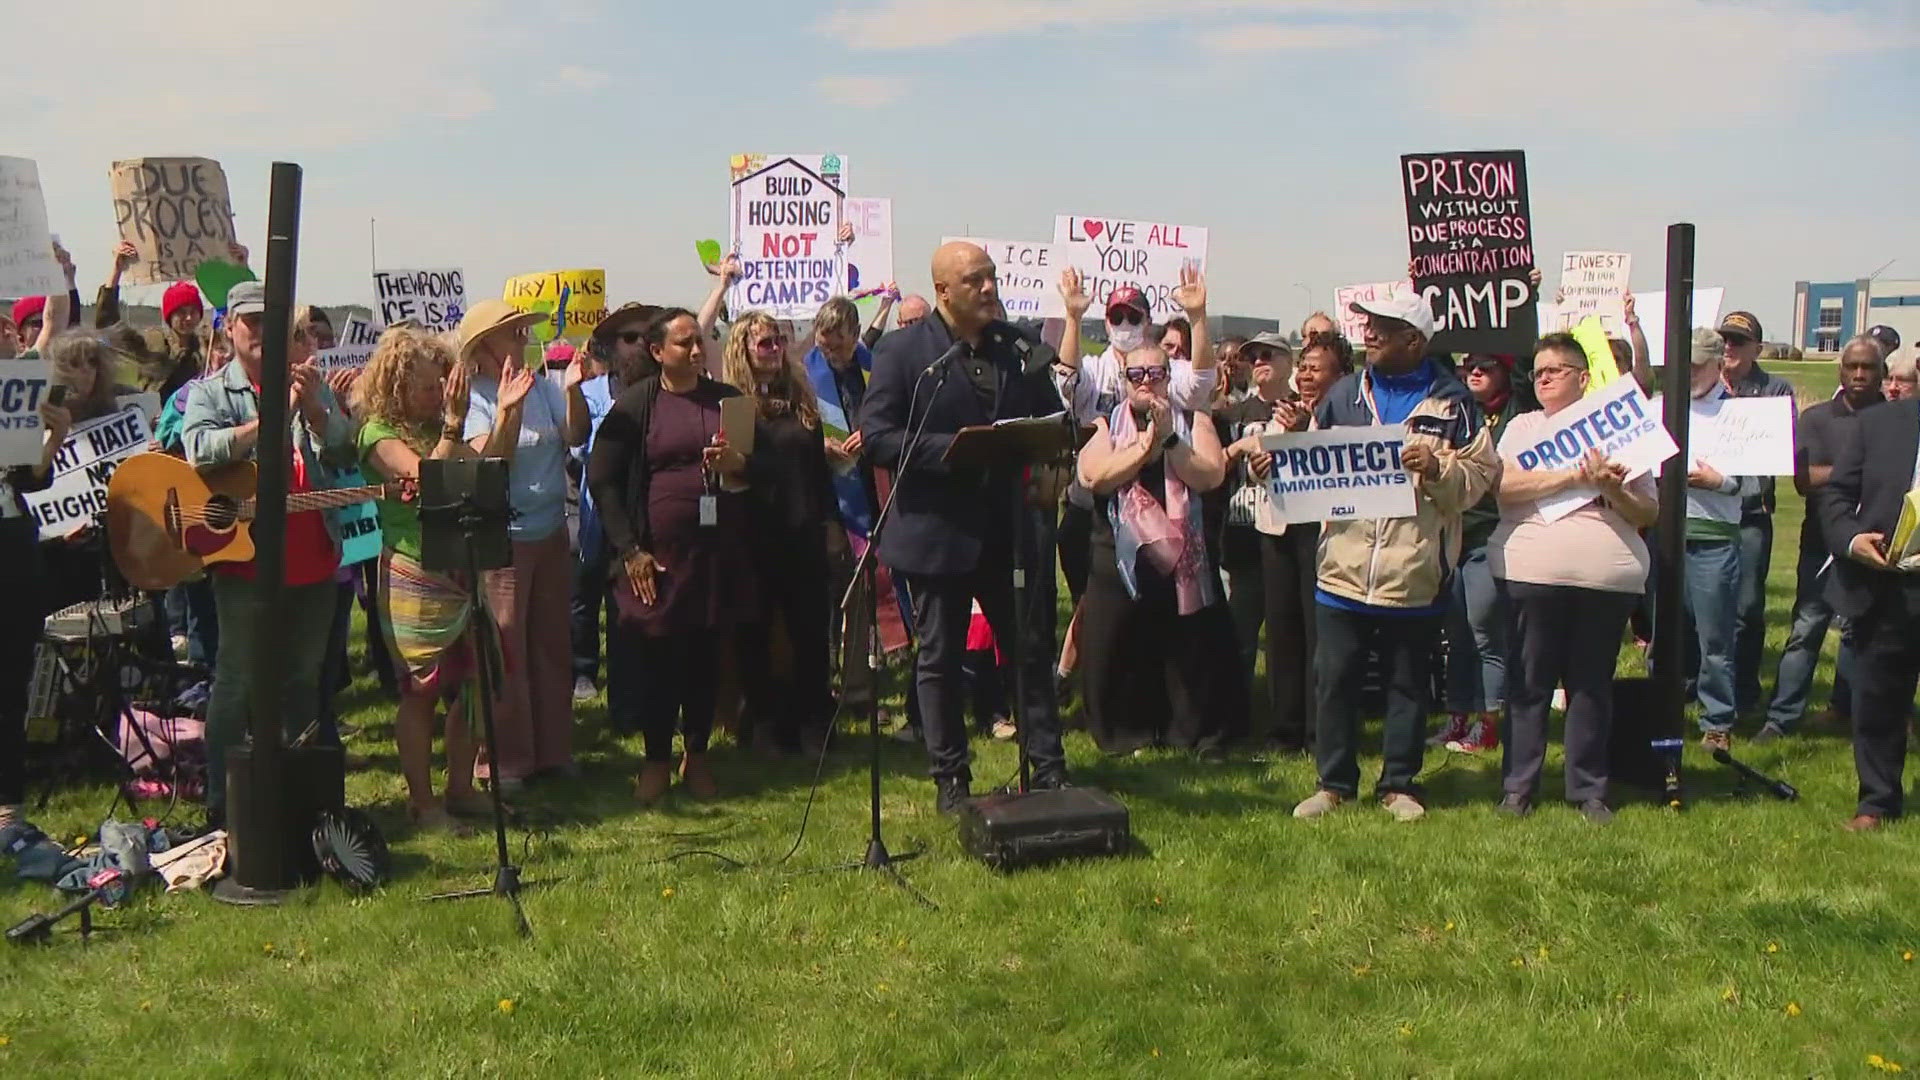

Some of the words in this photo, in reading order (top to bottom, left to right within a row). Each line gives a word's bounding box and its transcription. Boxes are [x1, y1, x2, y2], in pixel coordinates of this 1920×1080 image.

[131, 163, 208, 197] DUE
[766, 176, 812, 196] BUILD
[1407, 158, 1515, 200] PRISON
[114, 196, 235, 242] PROCESS
[749, 200, 831, 227] HOUSING
[1420, 199, 1519, 219] WITHOUT
[1147, 224, 1189, 248] ALL
[1411, 222, 1448, 243] DUE
[1449, 216, 1526, 240] PROCESS
[158, 241, 175, 259] IS
[187, 241, 206, 256] A
[762, 232, 818, 259] NOT
[1449, 240, 1466, 250] IS
[1472, 238, 1483, 249] A
[1004, 246, 1048, 267] ICE
[1095, 244, 1149, 276] YOUR
[1413, 245, 1532, 278] CONCENTRATION
[1564, 254, 1627, 271] INVEST
[147, 259, 198, 282] RIG
[744, 259, 834, 280] DETENTION
[996, 271, 1044, 290] ntion
[373, 272, 412, 299] THE
[411, 271, 464, 298] WRONG
[513, 278, 545, 298] TRY
[551, 271, 603, 296] TALKS
[747, 280, 830, 305] CAMPS
[1337, 285, 1375, 304] End
[424, 300, 444, 324] IS
[1006, 300, 1040, 312] ami
[1421, 278, 1530, 333] CAMP
[329, 351, 374, 368] Method
[87, 414, 144, 457] HATE
[1517, 389, 1645, 471] PROTECT
[1271, 440, 1404, 479] PROTECT
[1273, 473, 1406, 494] IMMIGRANTS
